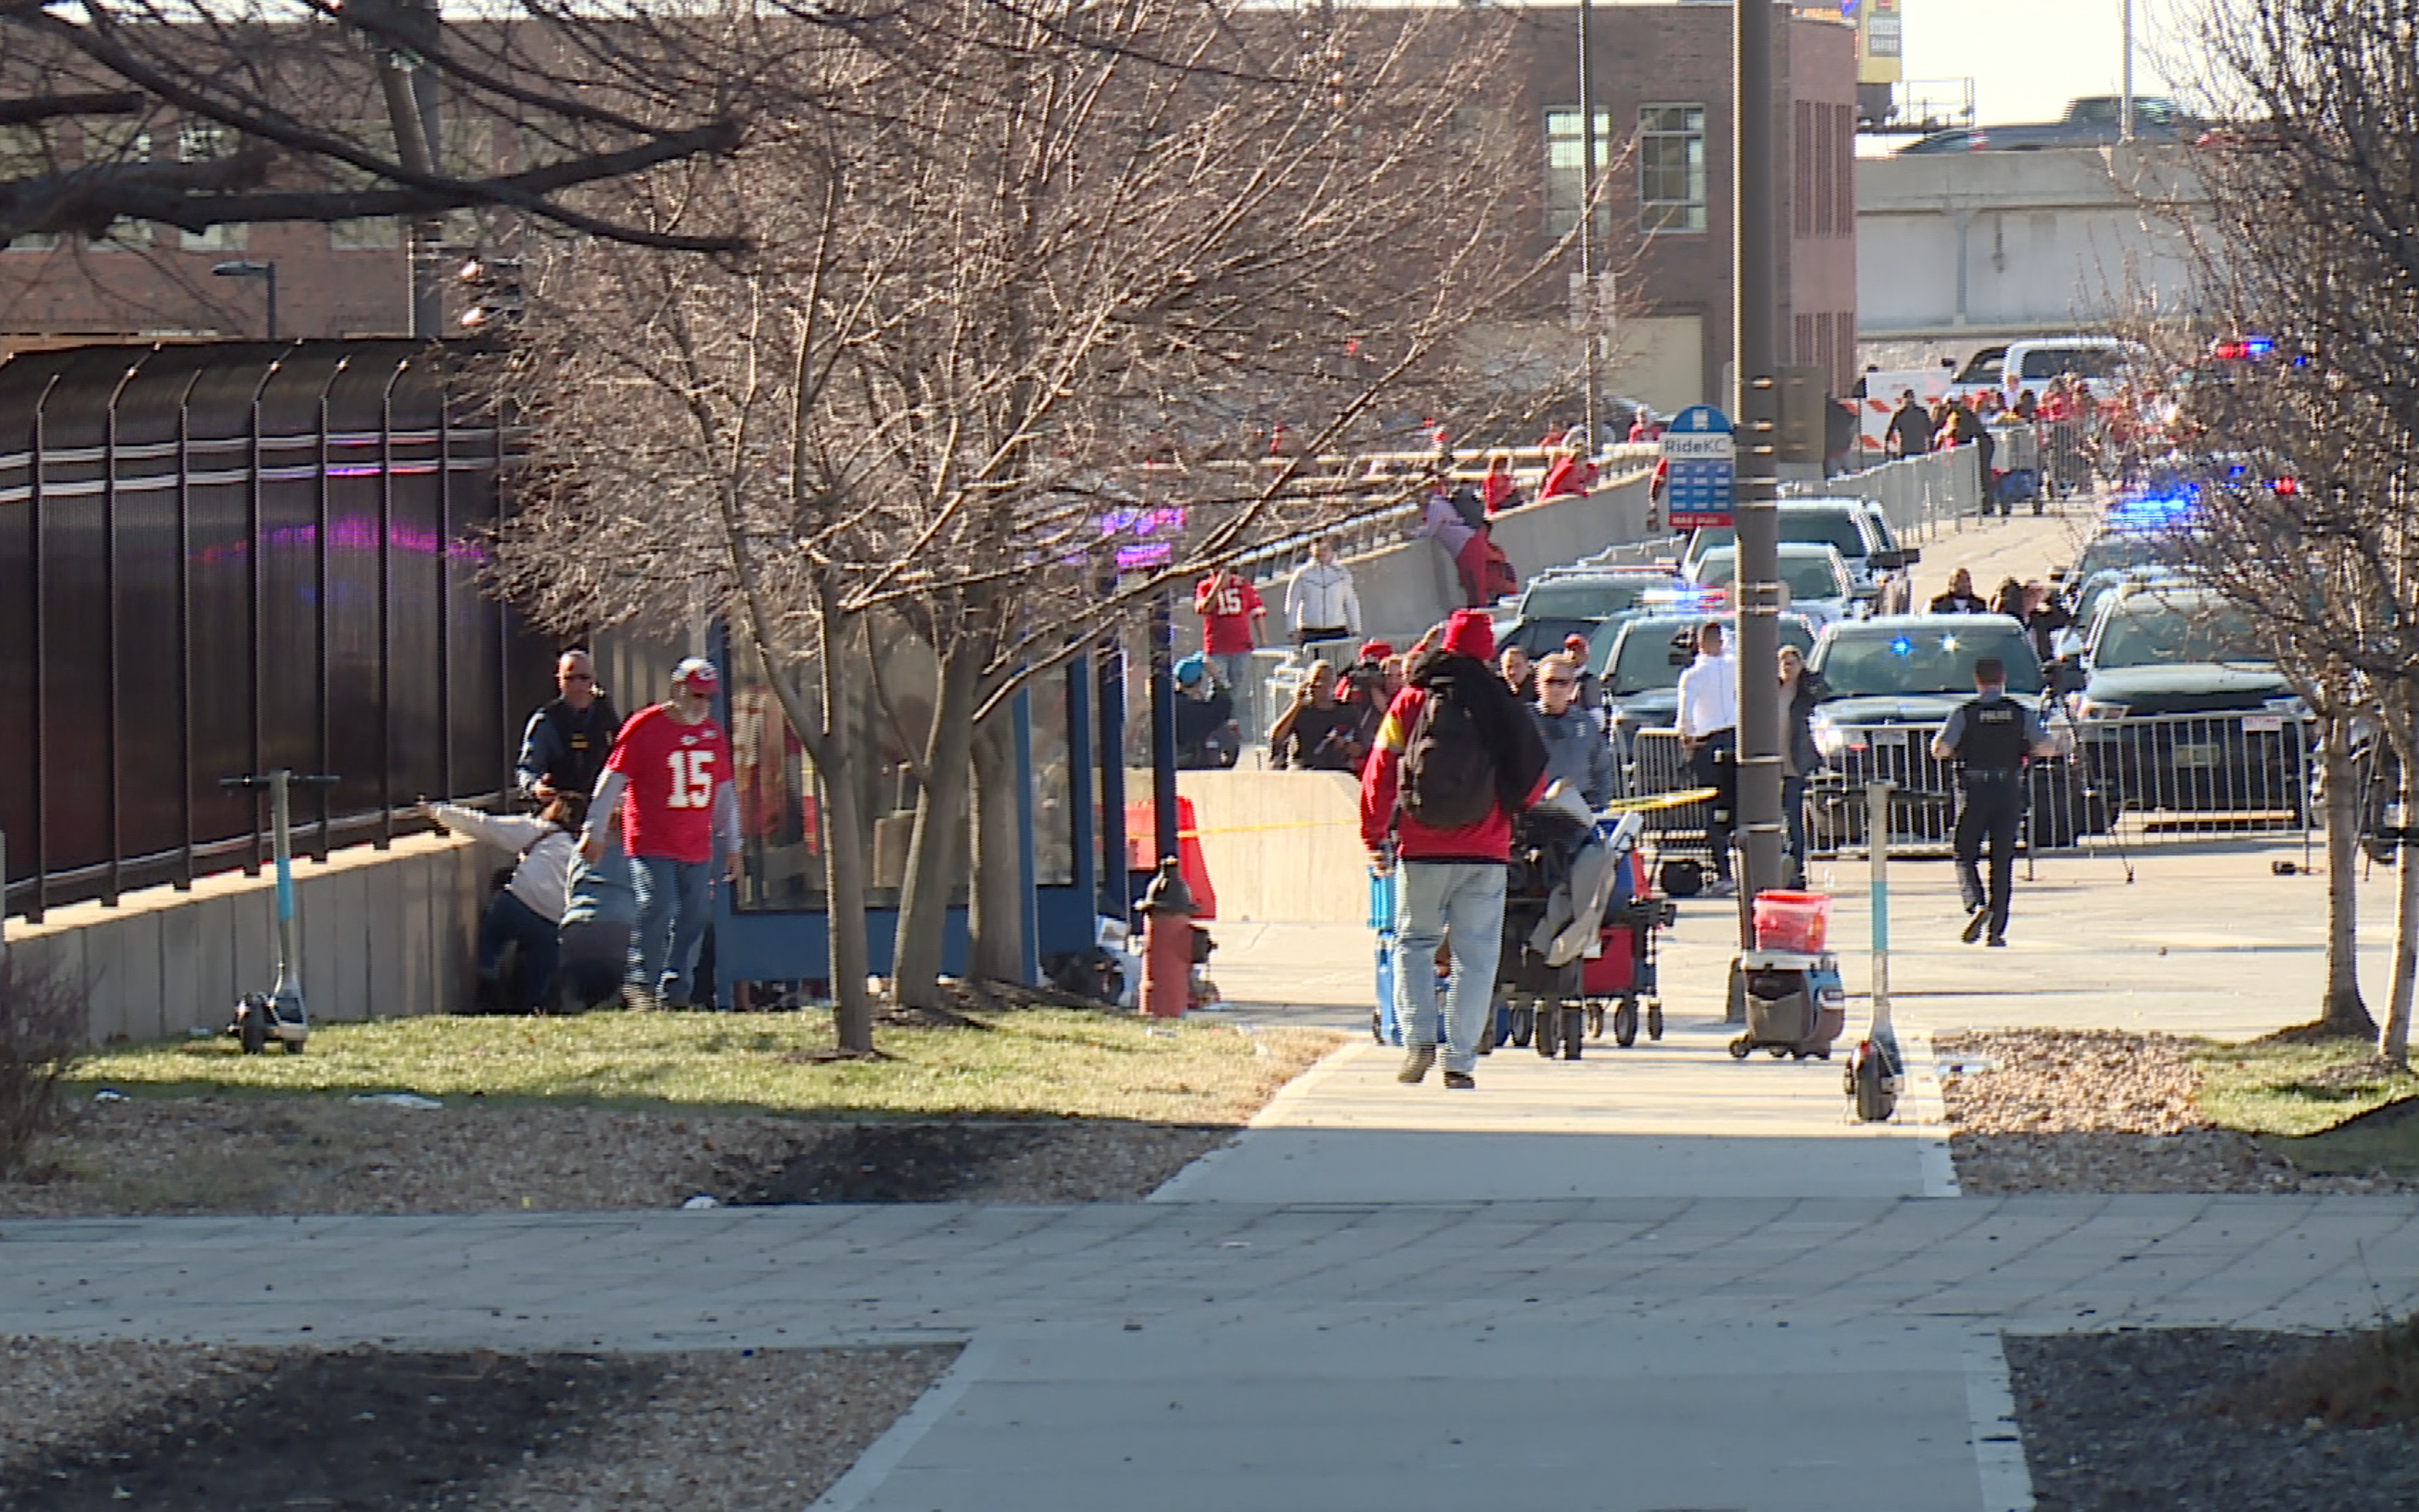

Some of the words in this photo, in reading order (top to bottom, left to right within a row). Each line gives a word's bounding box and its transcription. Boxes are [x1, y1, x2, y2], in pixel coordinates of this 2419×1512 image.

[1664, 438, 1727, 452] RideKC
[1218, 587, 1242, 615] 15
[666, 750, 715, 808] 15
